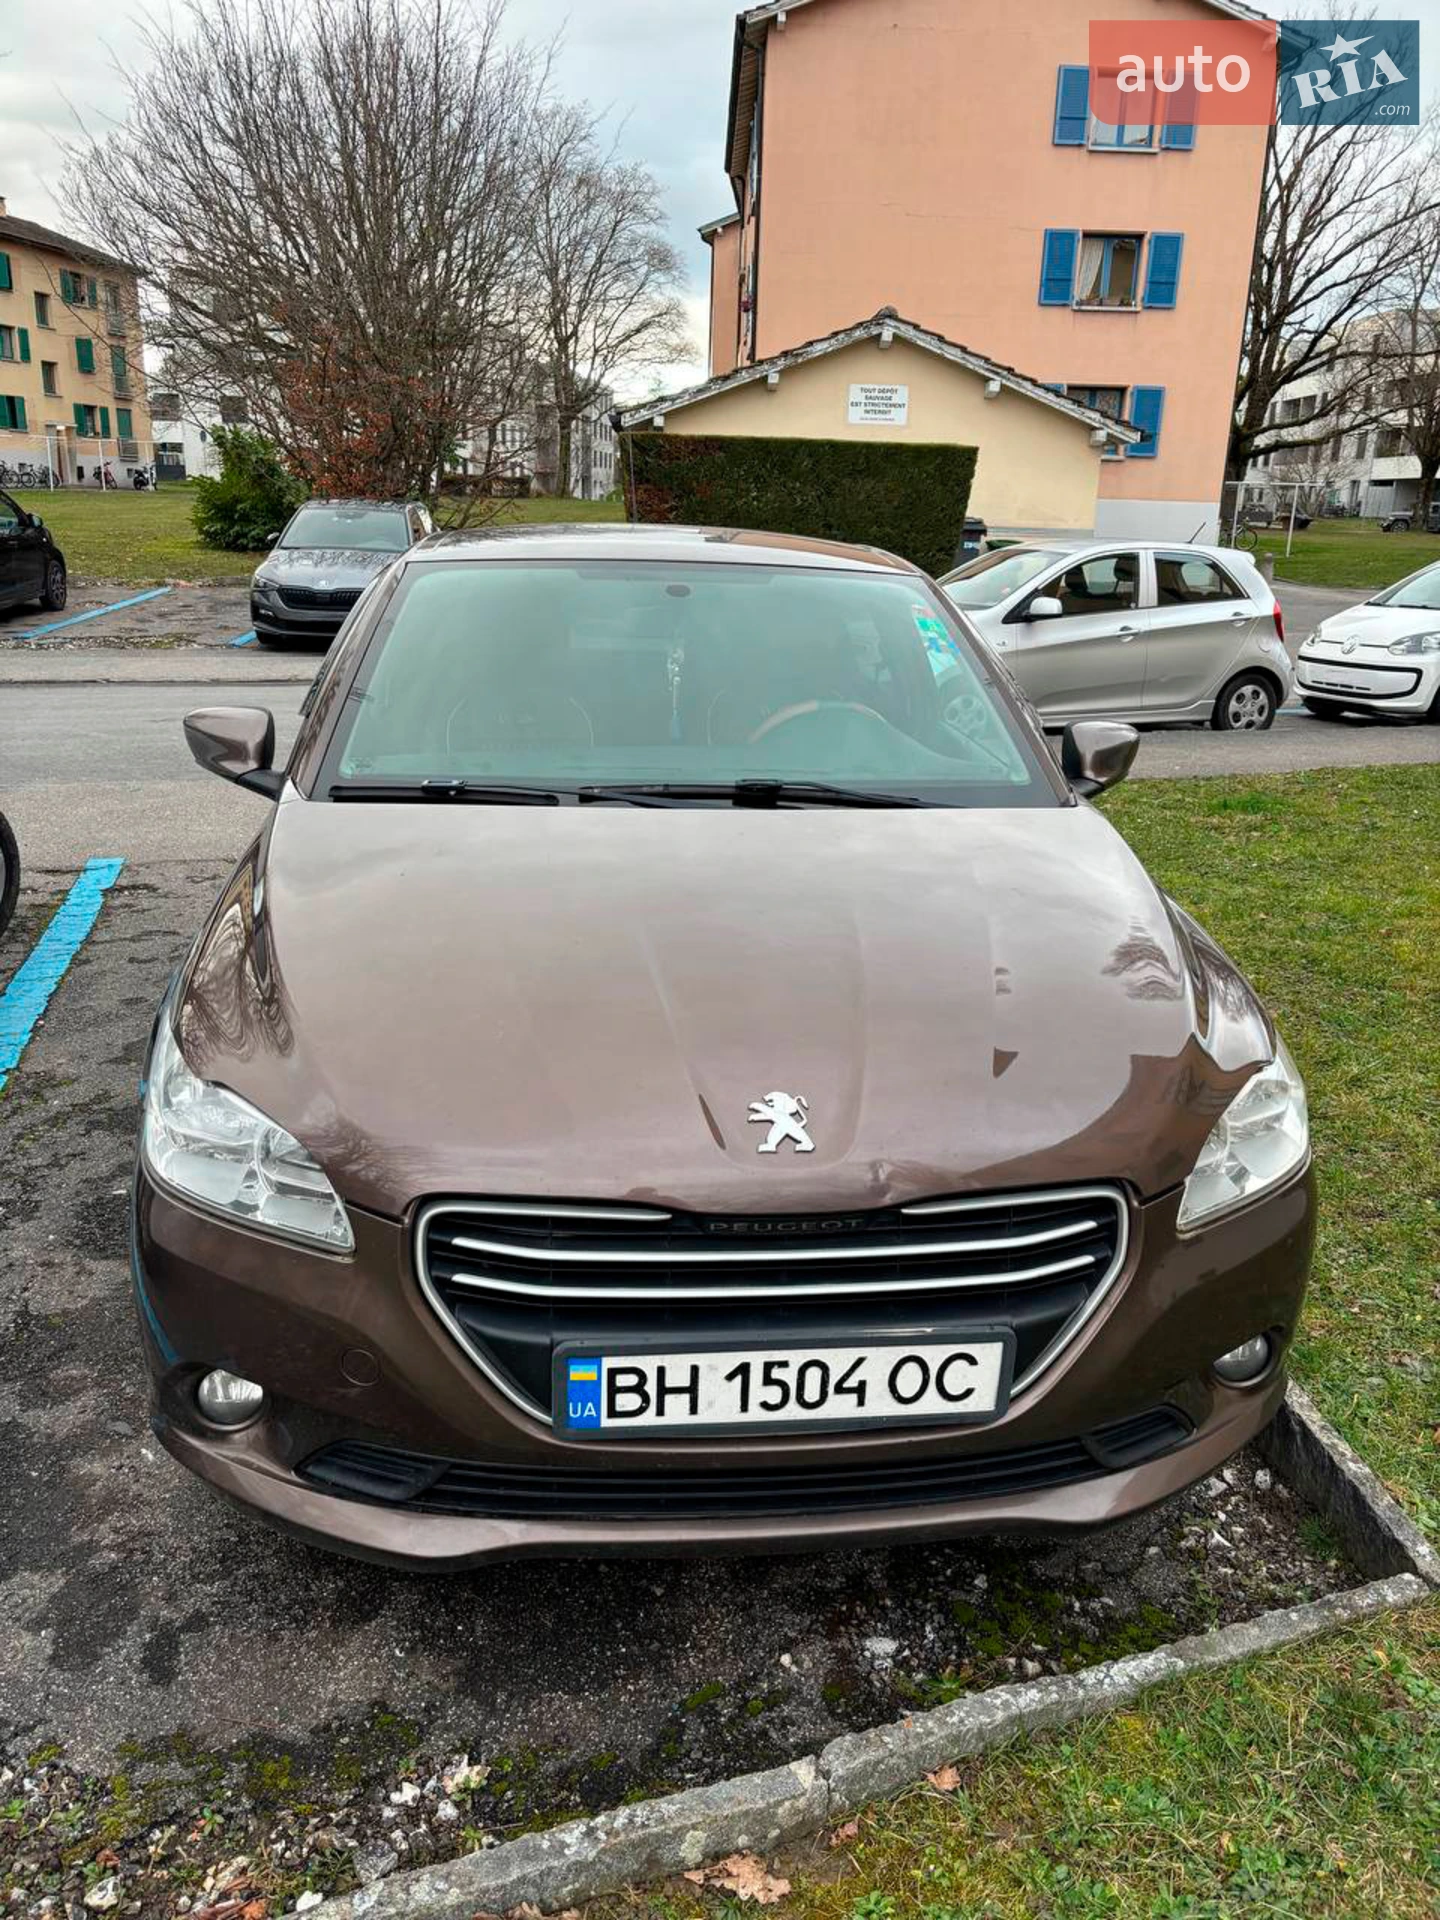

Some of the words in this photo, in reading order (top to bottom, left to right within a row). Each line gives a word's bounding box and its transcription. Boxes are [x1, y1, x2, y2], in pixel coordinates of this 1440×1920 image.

[709, 1219, 864, 1232] PEUGEOT
[606, 1364, 699, 1419] BH
[724, 1356, 867, 1413] 1504
[887, 1352, 978, 1405] OC
[569, 1401, 597, 1418] UA
